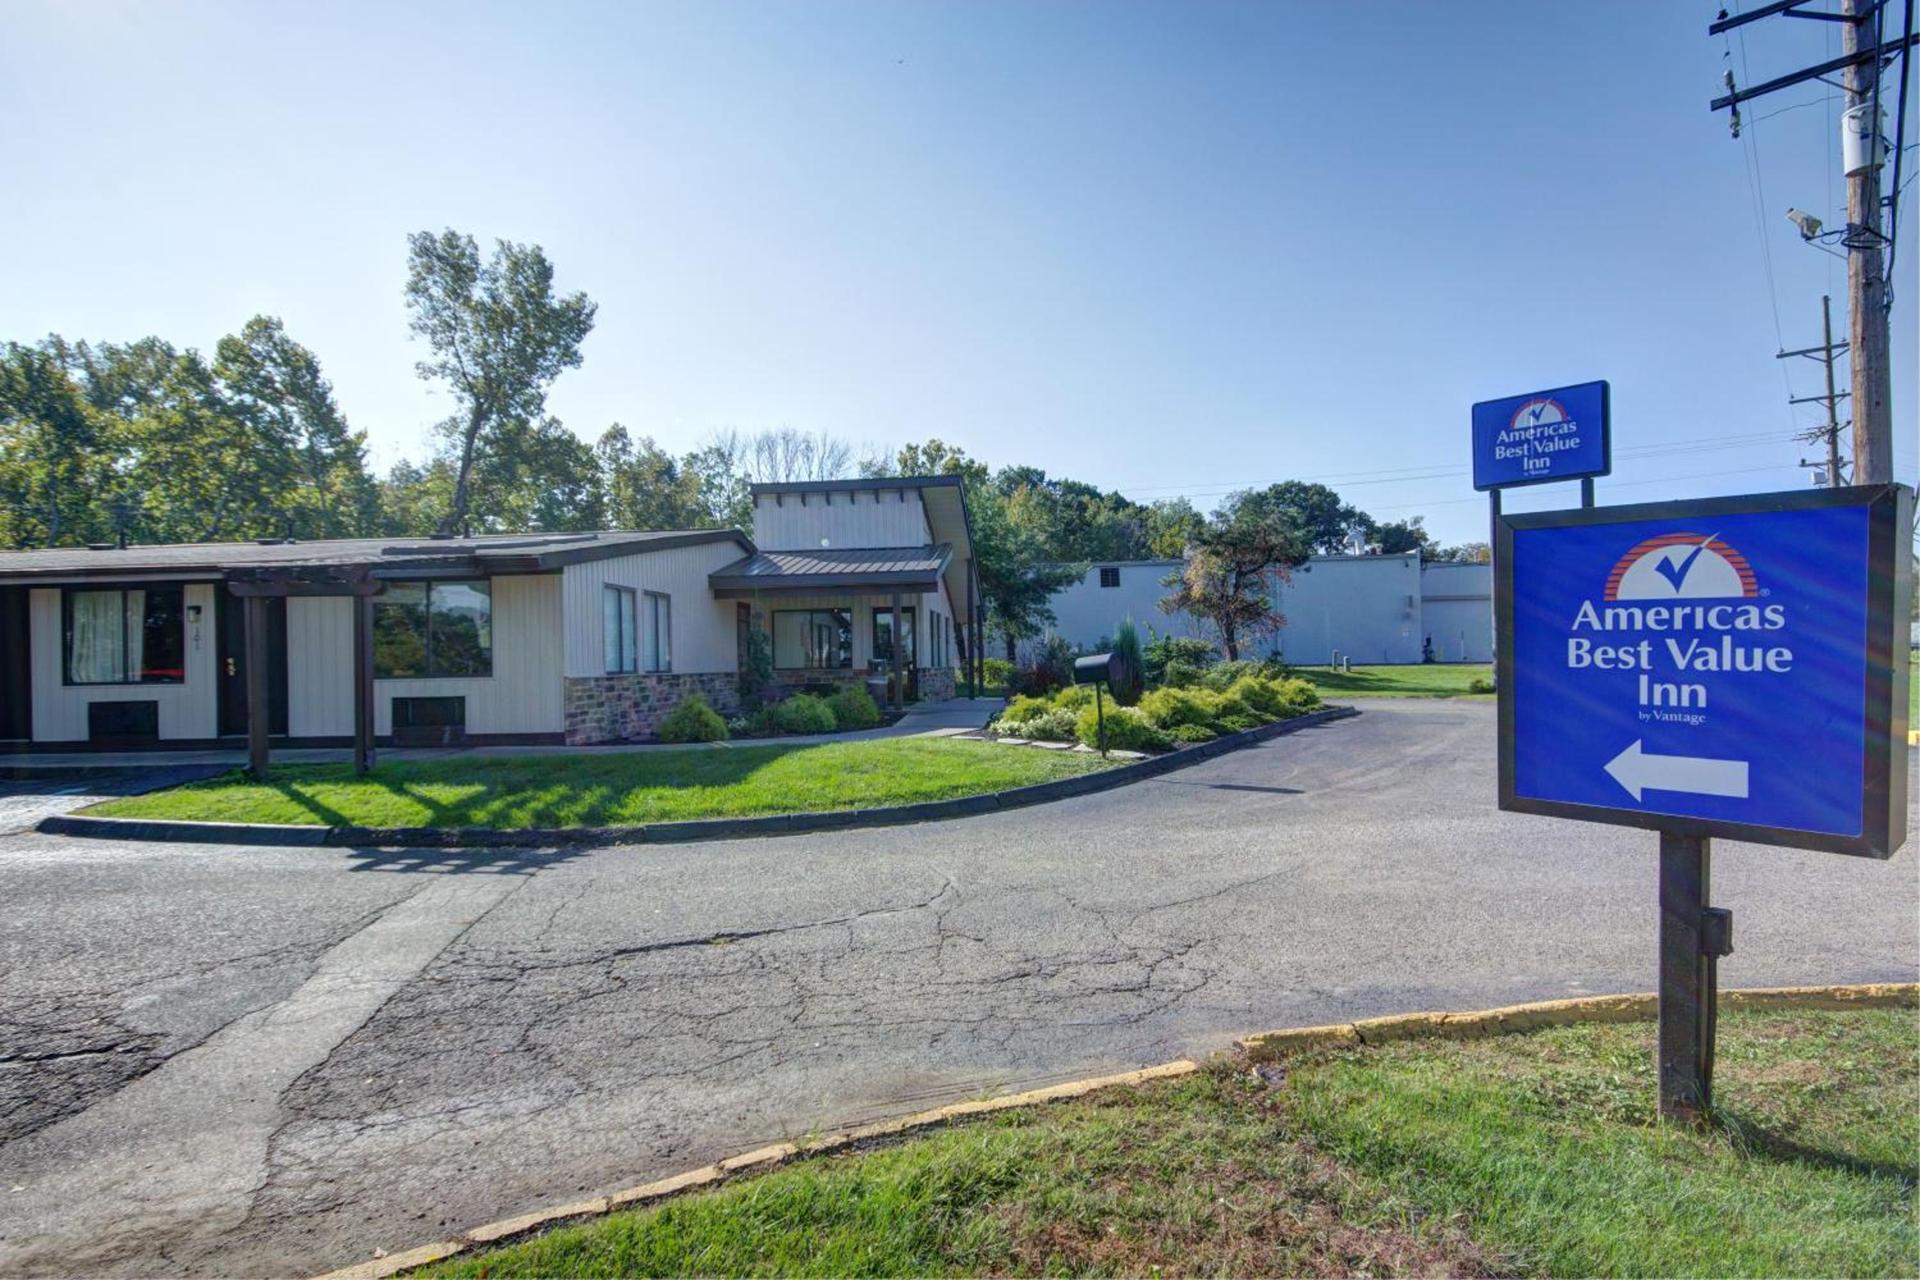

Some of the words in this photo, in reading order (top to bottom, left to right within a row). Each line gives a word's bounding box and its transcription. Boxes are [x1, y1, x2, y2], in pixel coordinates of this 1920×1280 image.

[1496, 421, 1577, 444] Americas
[1495, 442, 1529, 460] Best
[1533, 436, 1581, 454] Value
[1523, 456, 1550, 471] Inn
[1571, 600, 1786, 631] Americas
[1567, 637, 1653, 671] Best
[1664, 634, 1793, 673] Value
[1638, 674, 1707, 708] Inn
[1639, 711, 1651, 723] by
[1653, 710, 1706, 726] Vantage
